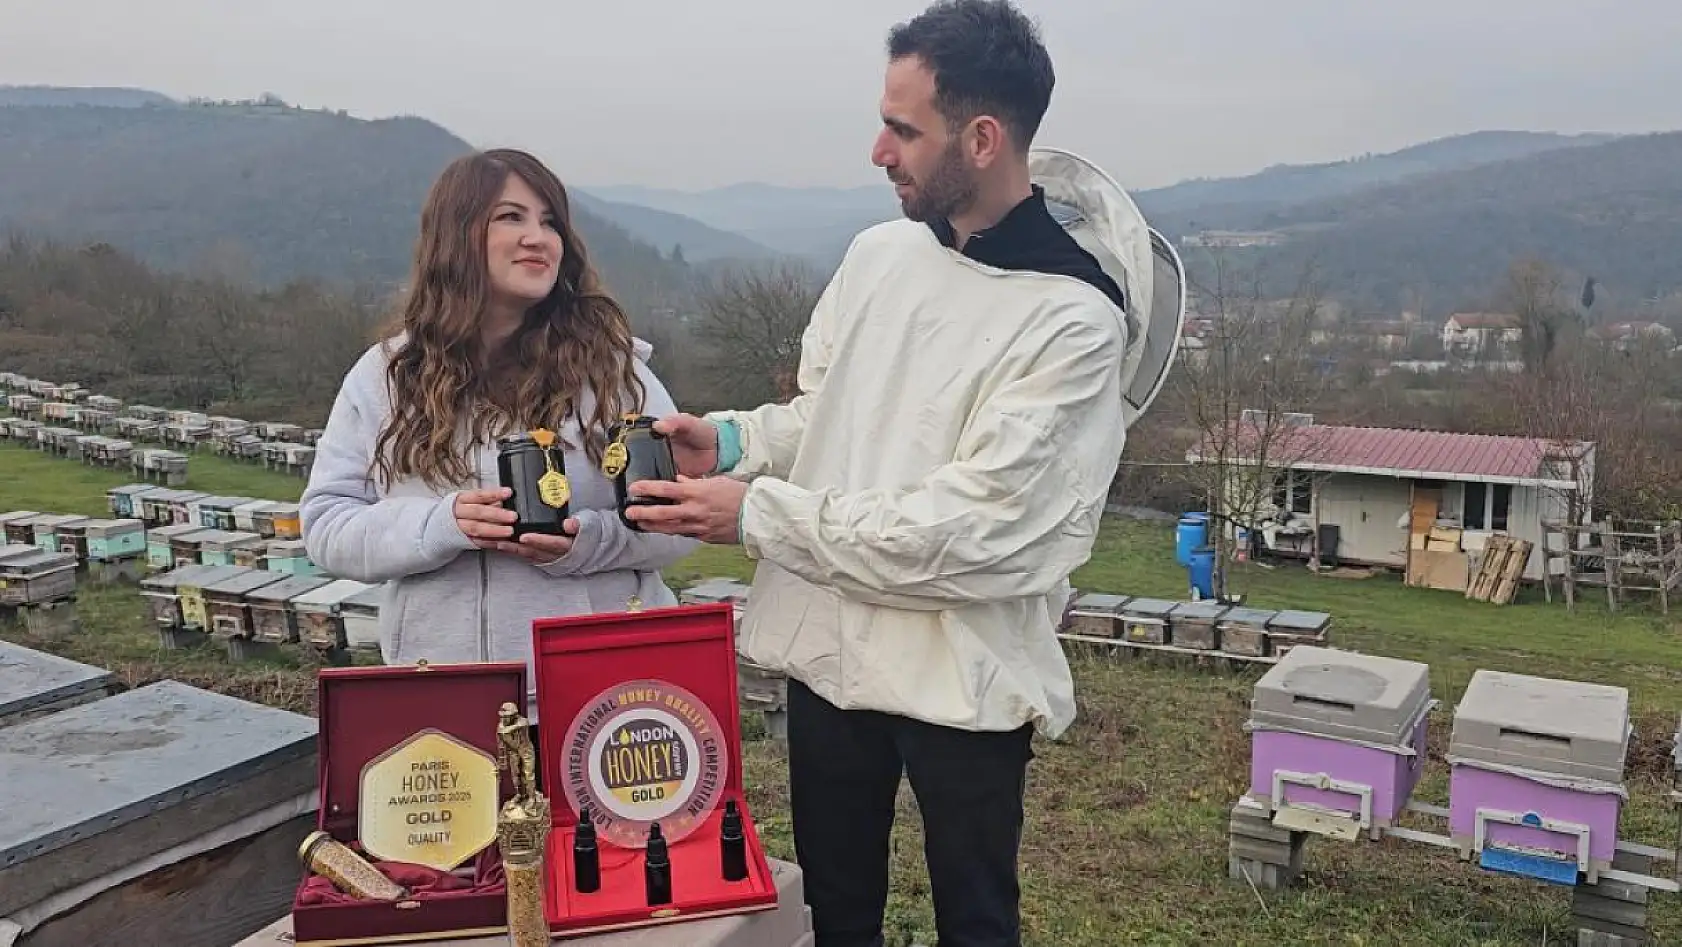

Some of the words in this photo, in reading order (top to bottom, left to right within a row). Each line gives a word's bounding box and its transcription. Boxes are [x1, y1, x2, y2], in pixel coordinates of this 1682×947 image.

[618, 689, 662, 705] HONEY
[666, 695, 711, 734] QUALITY
[567, 699, 618, 785] INTERNATIONAL
[610, 726, 674, 745] LONDON
[411, 761, 450, 772] PARIS
[606, 741, 671, 785] HONEY
[402, 772, 460, 792] HONEY
[687, 737, 718, 817] COMPETITION
[388, 793, 446, 806] AWARDS
[632, 786, 664, 802] GOLD
[405, 810, 453, 824] GOLD
[407, 831, 452, 846] QUALITY
